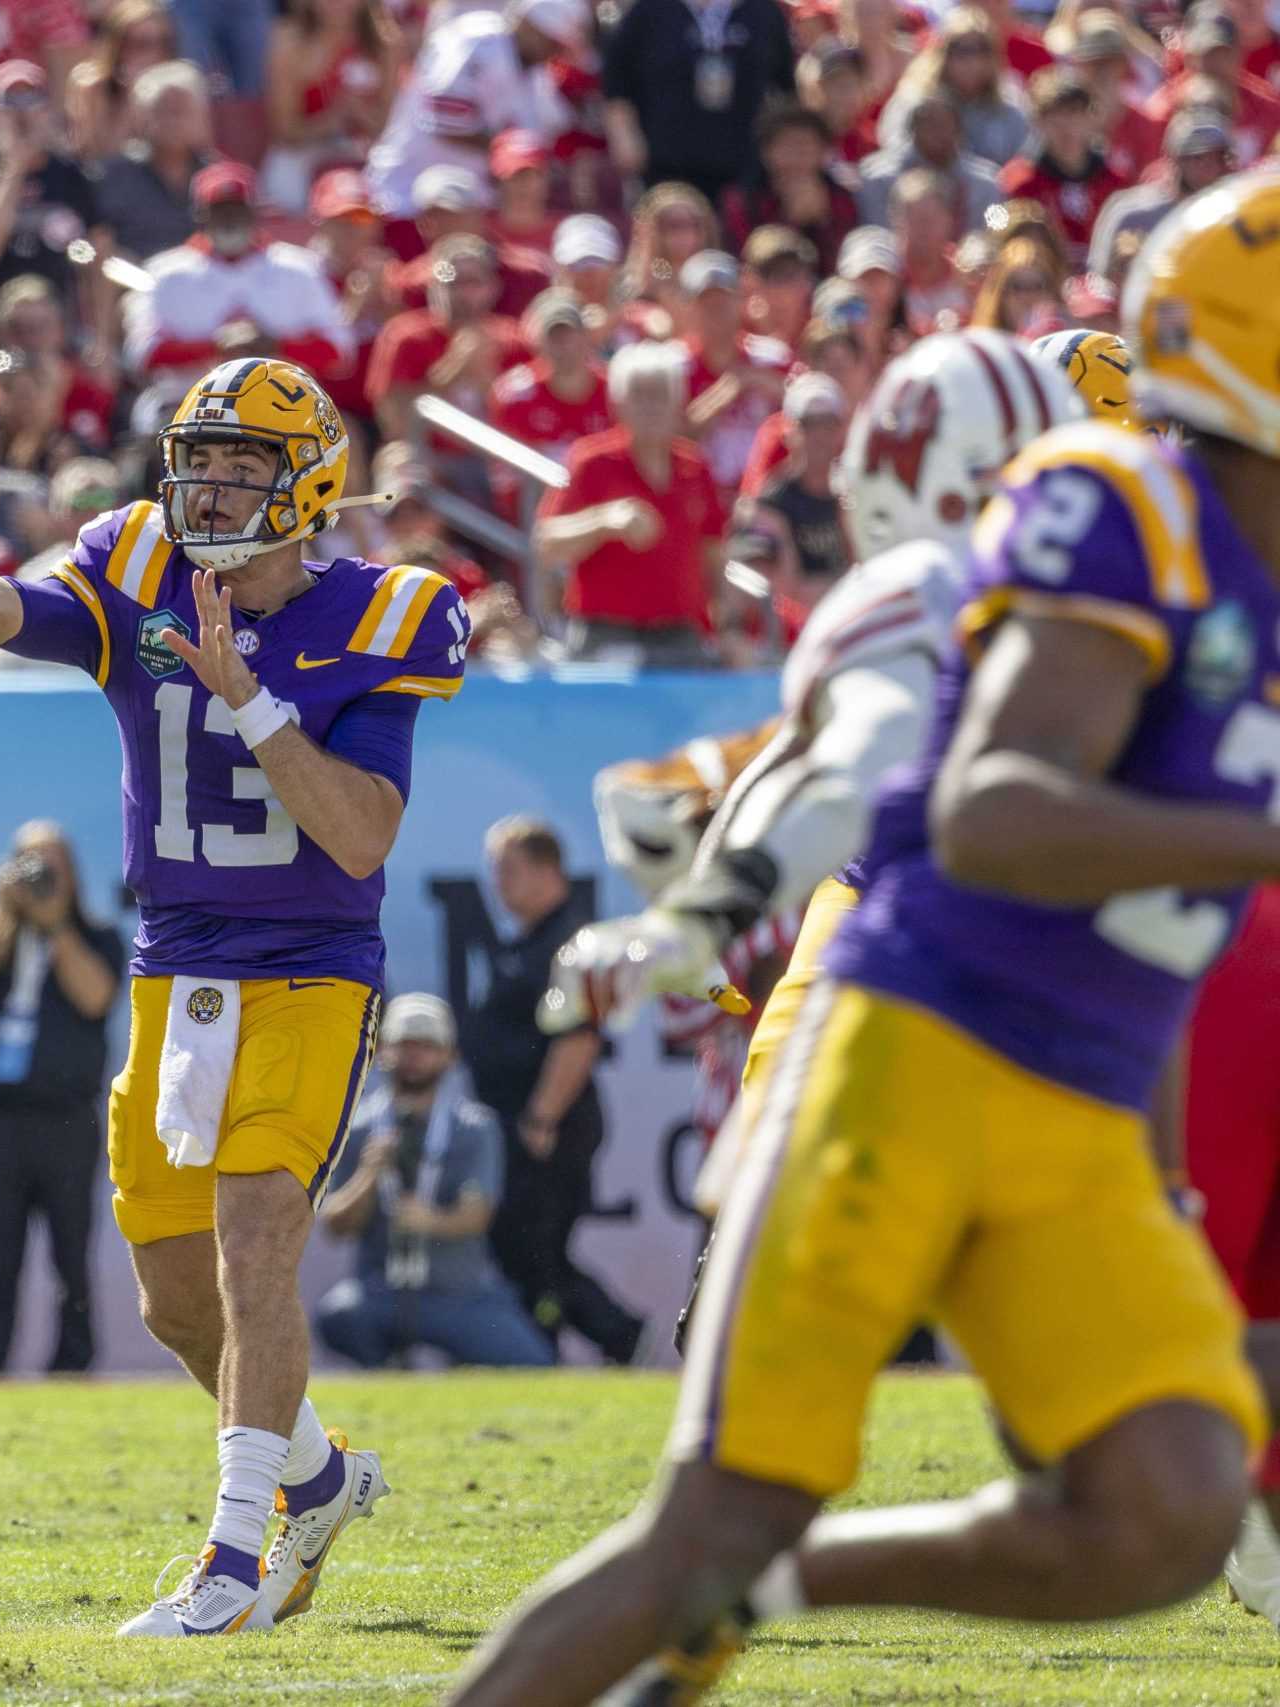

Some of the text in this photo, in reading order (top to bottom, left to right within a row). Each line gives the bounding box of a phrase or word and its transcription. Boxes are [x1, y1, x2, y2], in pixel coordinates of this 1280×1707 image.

[195, 408, 225, 420] LSU
[1018, 472, 1102, 584] 2
[234, 631, 258, 653] SEC
[154, 682, 301, 867] 13
[355, 1471, 372, 1506] LSU
